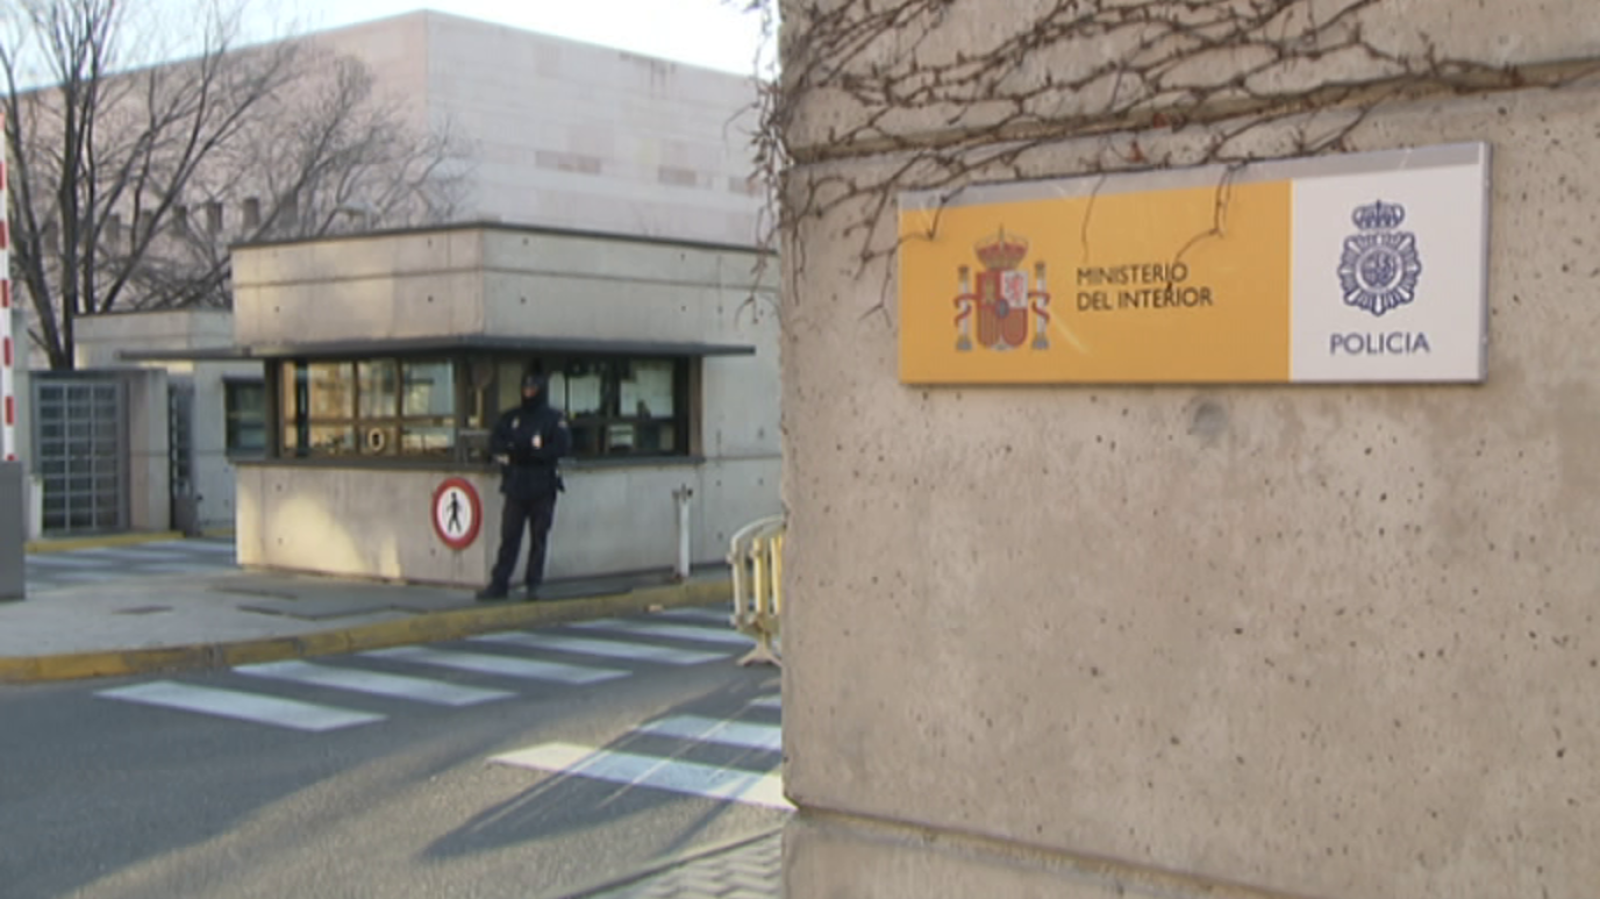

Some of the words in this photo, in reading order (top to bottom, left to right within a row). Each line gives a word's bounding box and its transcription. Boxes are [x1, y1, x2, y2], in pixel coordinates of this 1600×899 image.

[1076, 262, 1189, 286] MINISTERIO
[1076, 290, 1113, 312] DEL
[1117, 286, 1214, 309] INTERIOR
[1329, 331, 1431, 355] POLICIA
